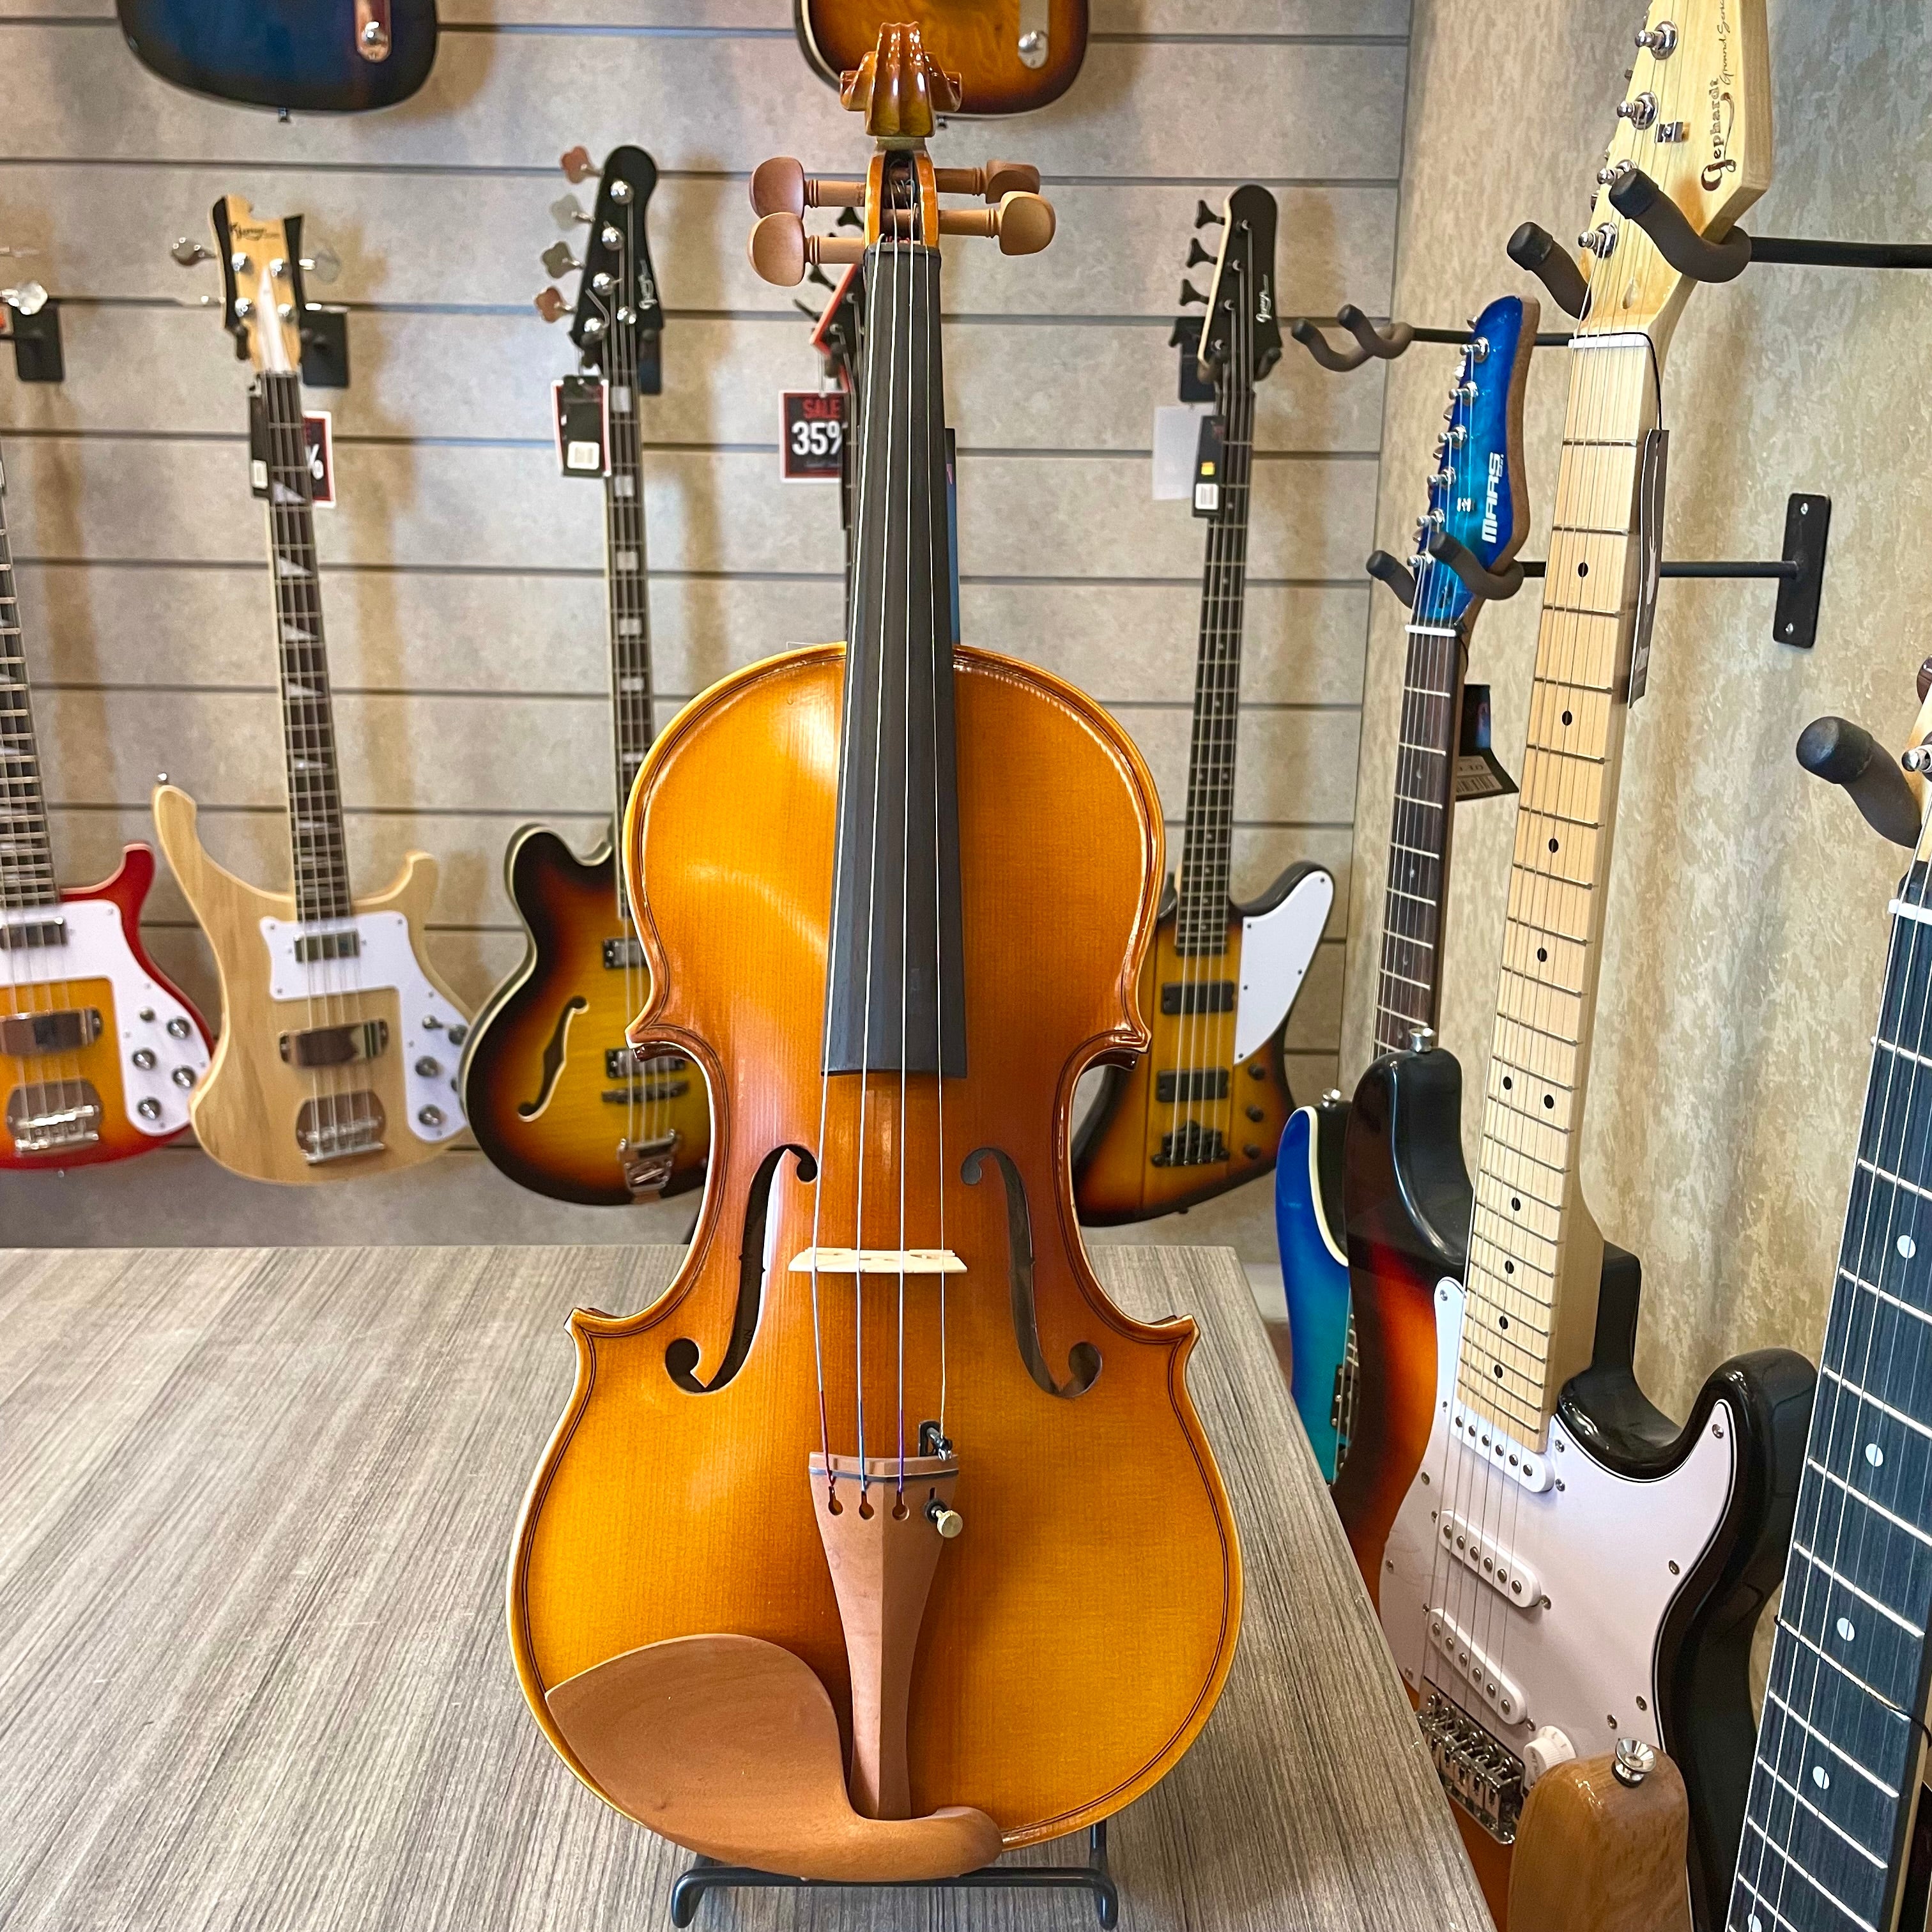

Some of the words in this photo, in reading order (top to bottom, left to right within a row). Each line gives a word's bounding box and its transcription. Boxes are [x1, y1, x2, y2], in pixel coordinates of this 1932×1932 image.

[1701, 77, 1736, 192] Gephardt
[802, 399, 841, 419] SALE
[1481, 452, 1501, 544] MARS
